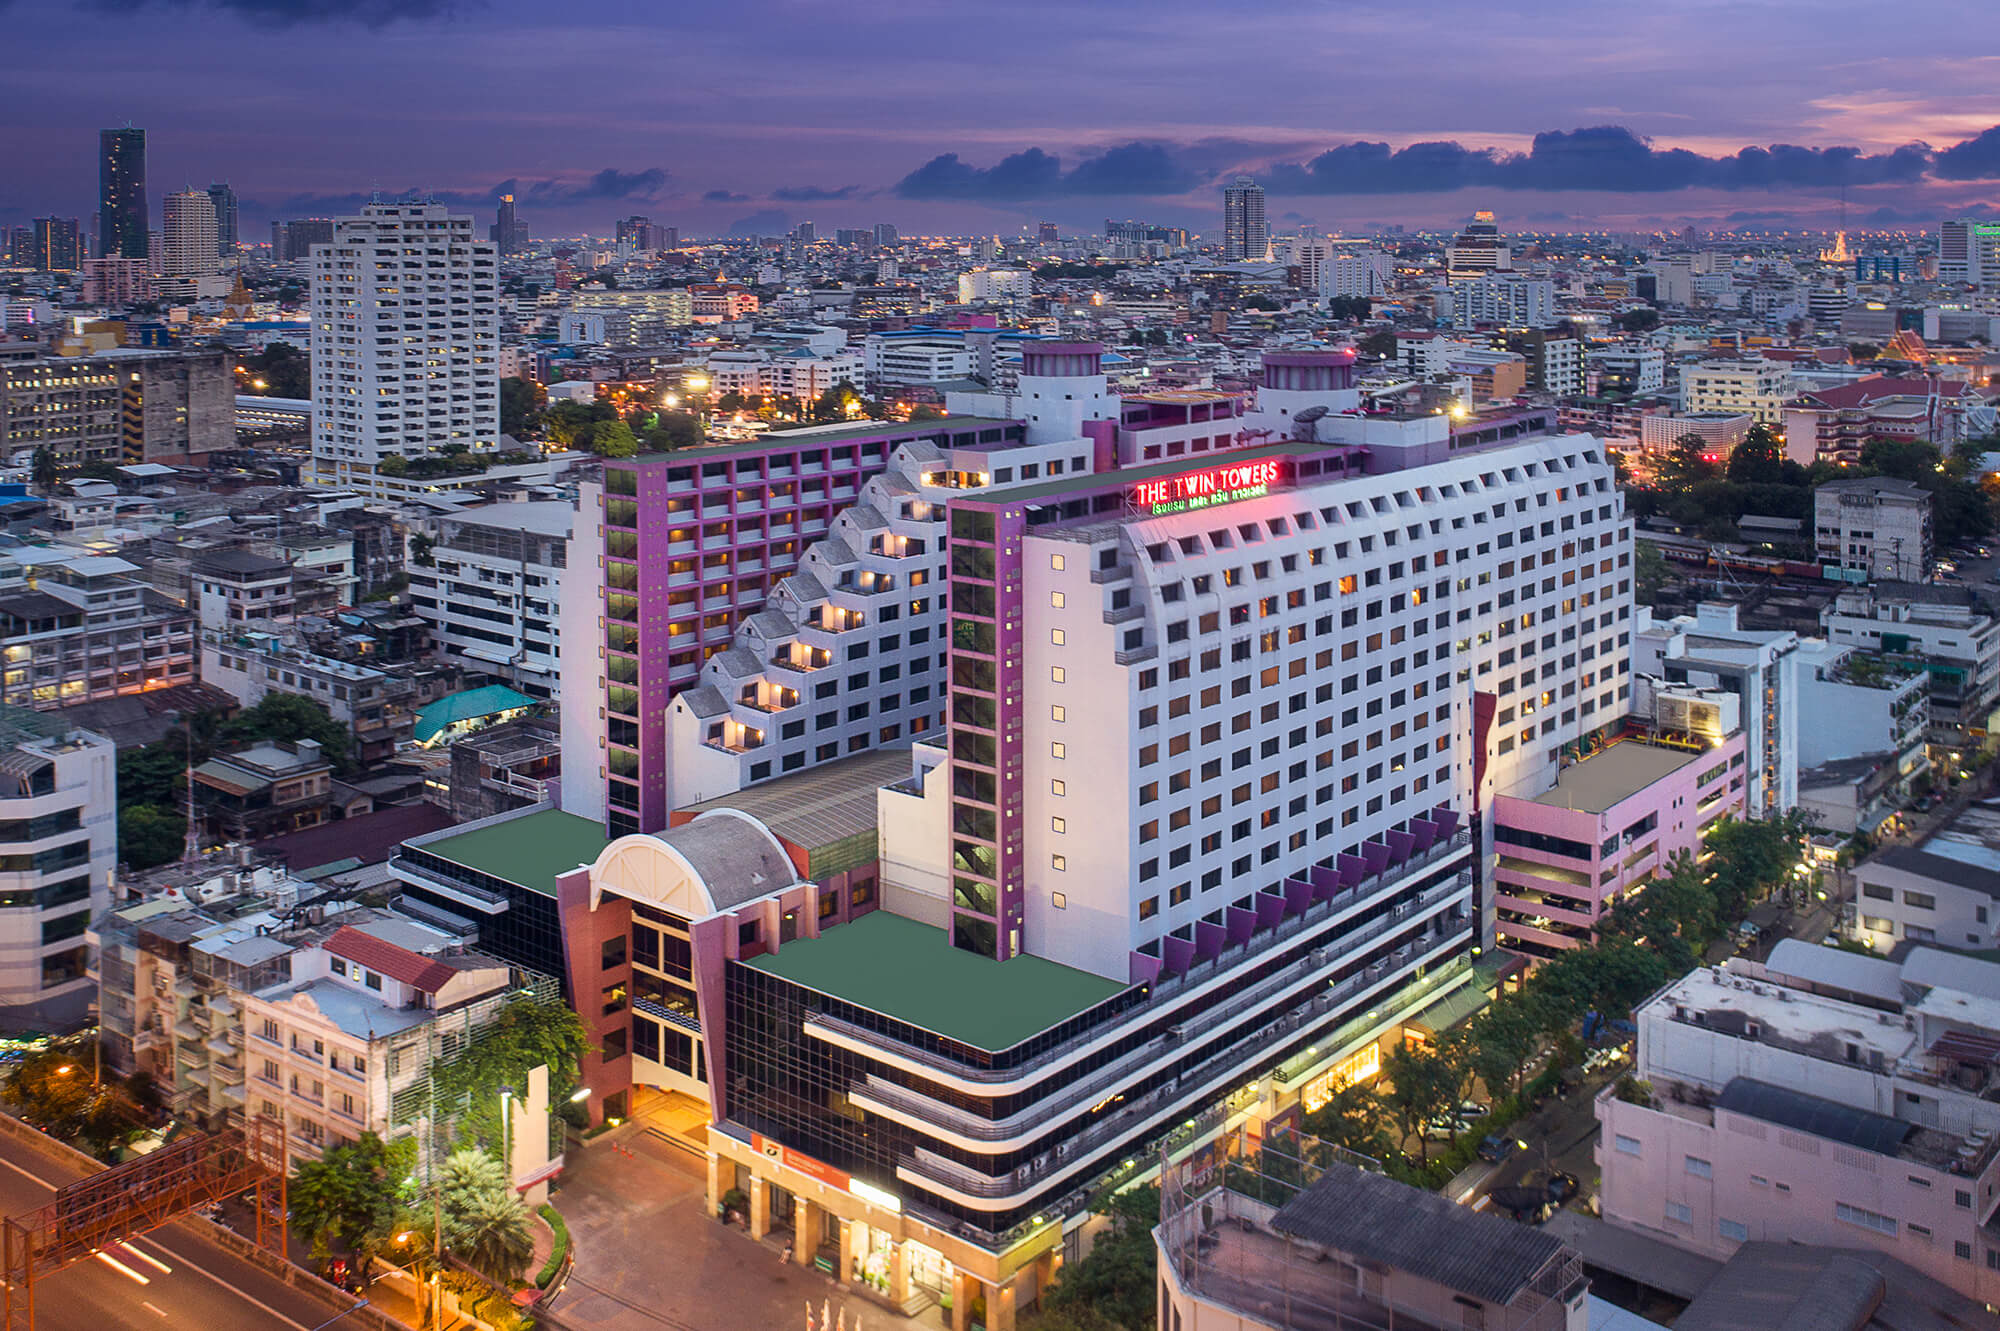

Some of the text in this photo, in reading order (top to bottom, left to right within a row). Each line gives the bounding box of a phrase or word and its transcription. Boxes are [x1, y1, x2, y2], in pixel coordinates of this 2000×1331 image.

[1137, 461, 1278, 504] THE TWIN TOWERS
